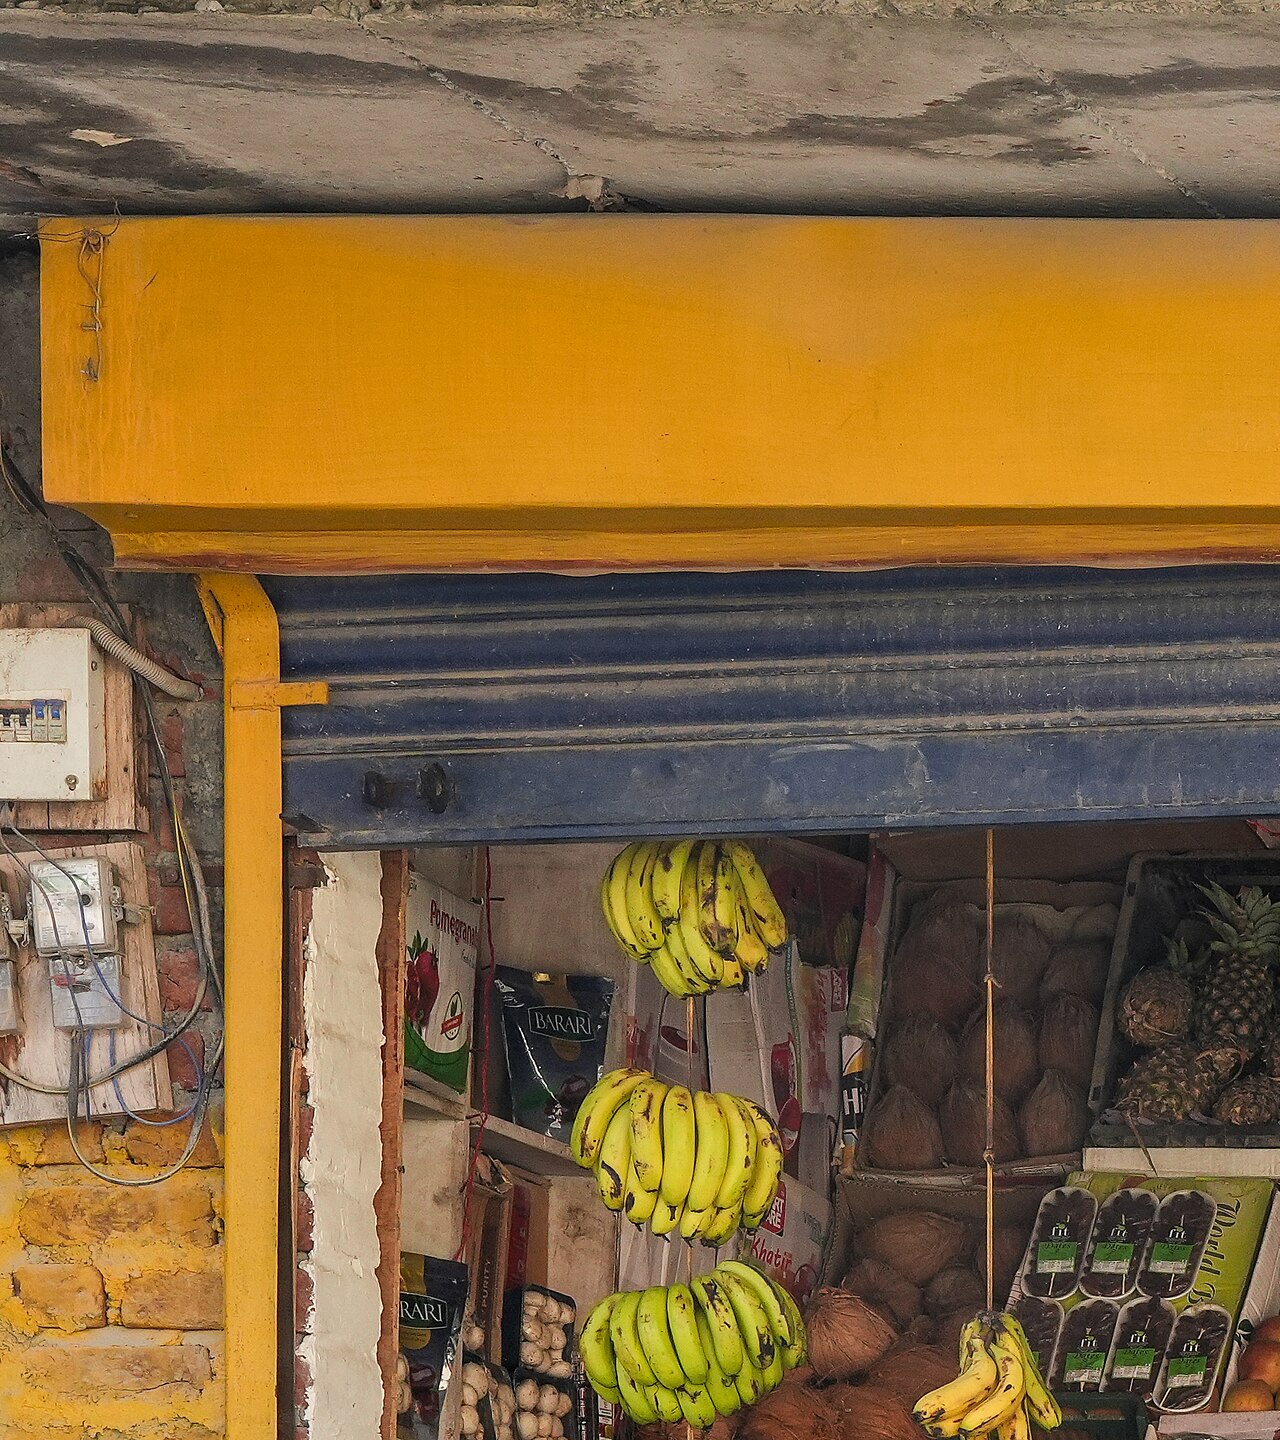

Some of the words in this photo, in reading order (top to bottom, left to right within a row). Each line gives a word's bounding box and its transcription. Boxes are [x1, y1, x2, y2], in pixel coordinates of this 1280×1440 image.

[534, 1011, 592, 1035] BARARI
[1050, 1225, 1070, 1238] fit
[1110, 1226, 1129, 1239] fit
[1168, 1226, 1188, 1240] fit
[480, 1257, 493, 1308] PURITY
[400, 1303, 442, 1323] RARI
[1079, 1336, 1098, 1348] fit
[1129, 1332, 1148, 1344] fit
[1182, 1341, 1201, 1353] fit
